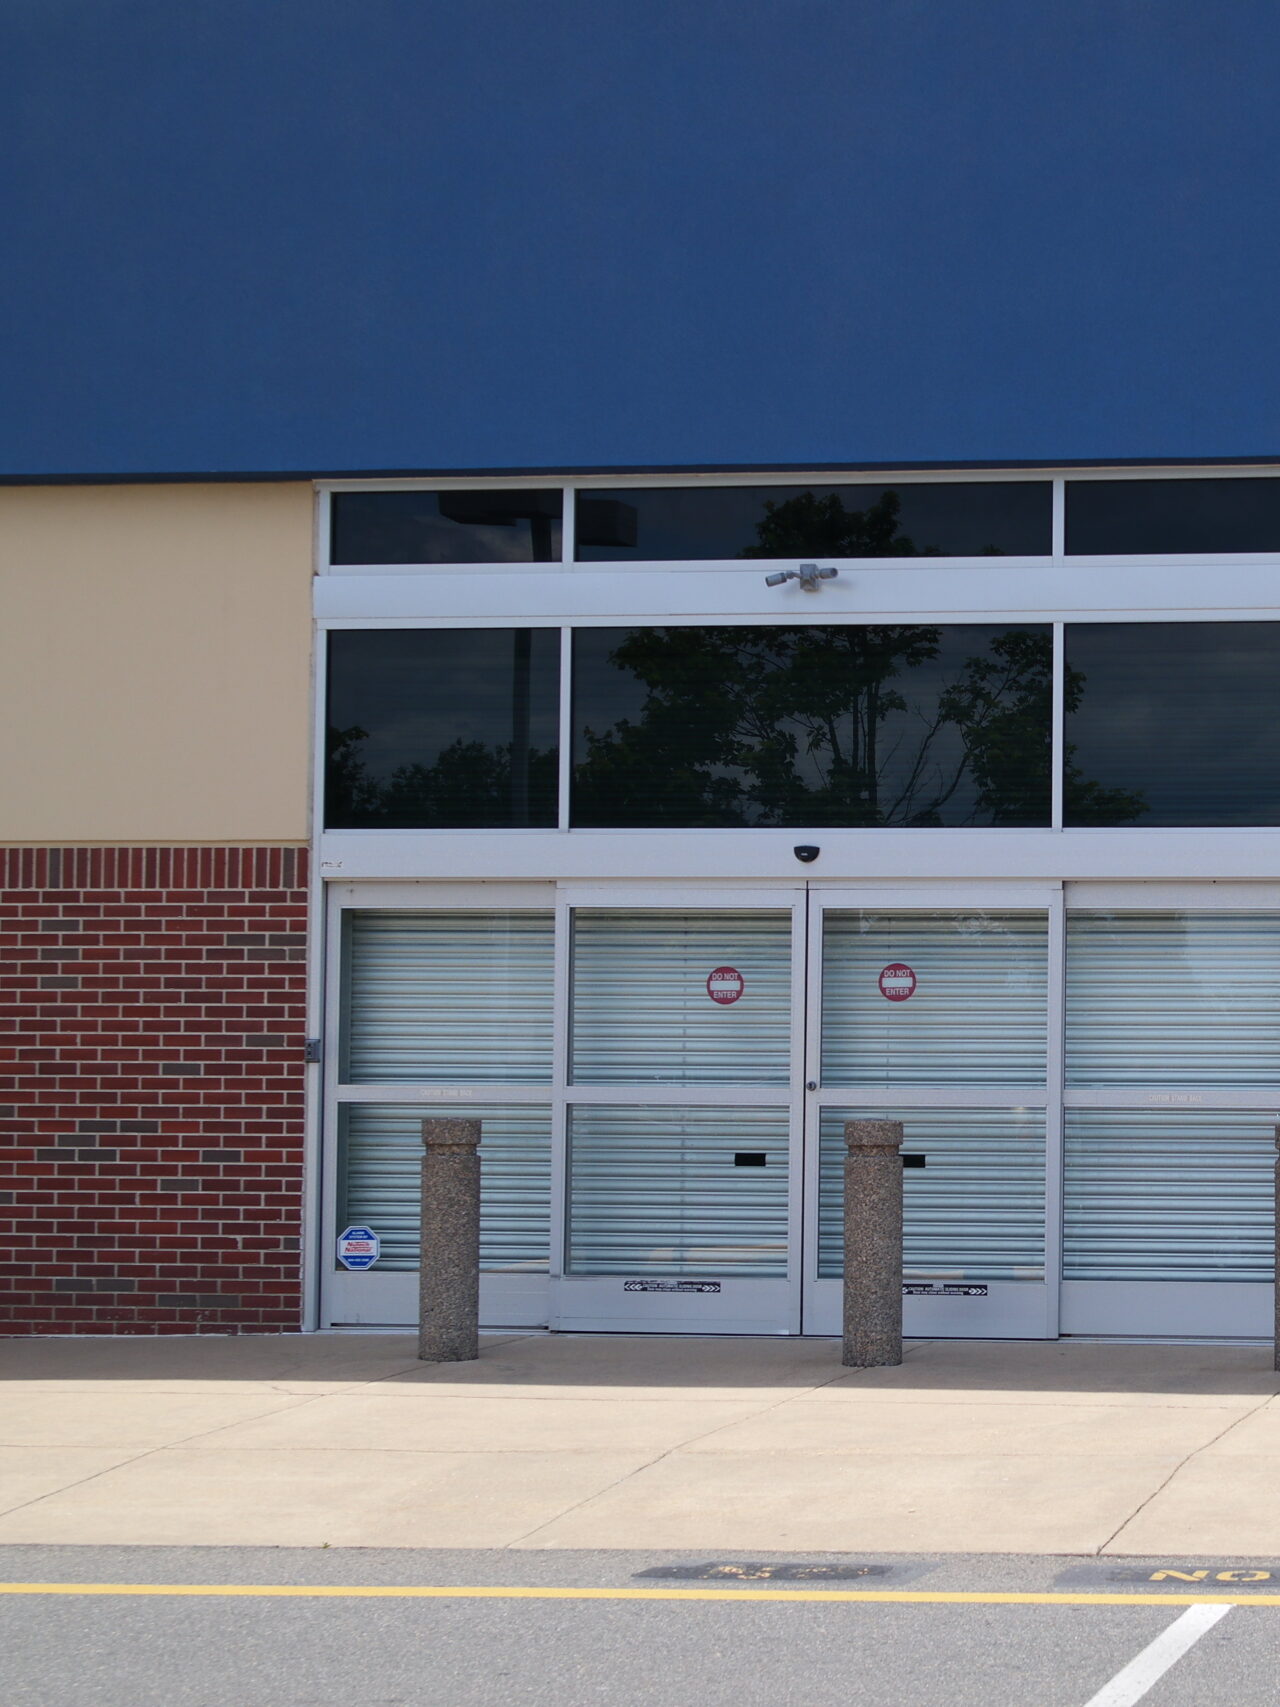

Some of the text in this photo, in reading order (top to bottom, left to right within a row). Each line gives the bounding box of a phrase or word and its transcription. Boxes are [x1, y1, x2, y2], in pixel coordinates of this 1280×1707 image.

[884, 969, 911, 977] DO NOT
[713, 991, 737, 999] ENTER
[886, 988, 910, 996] ENTER
[1149, 1570, 1271, 1581] NO
